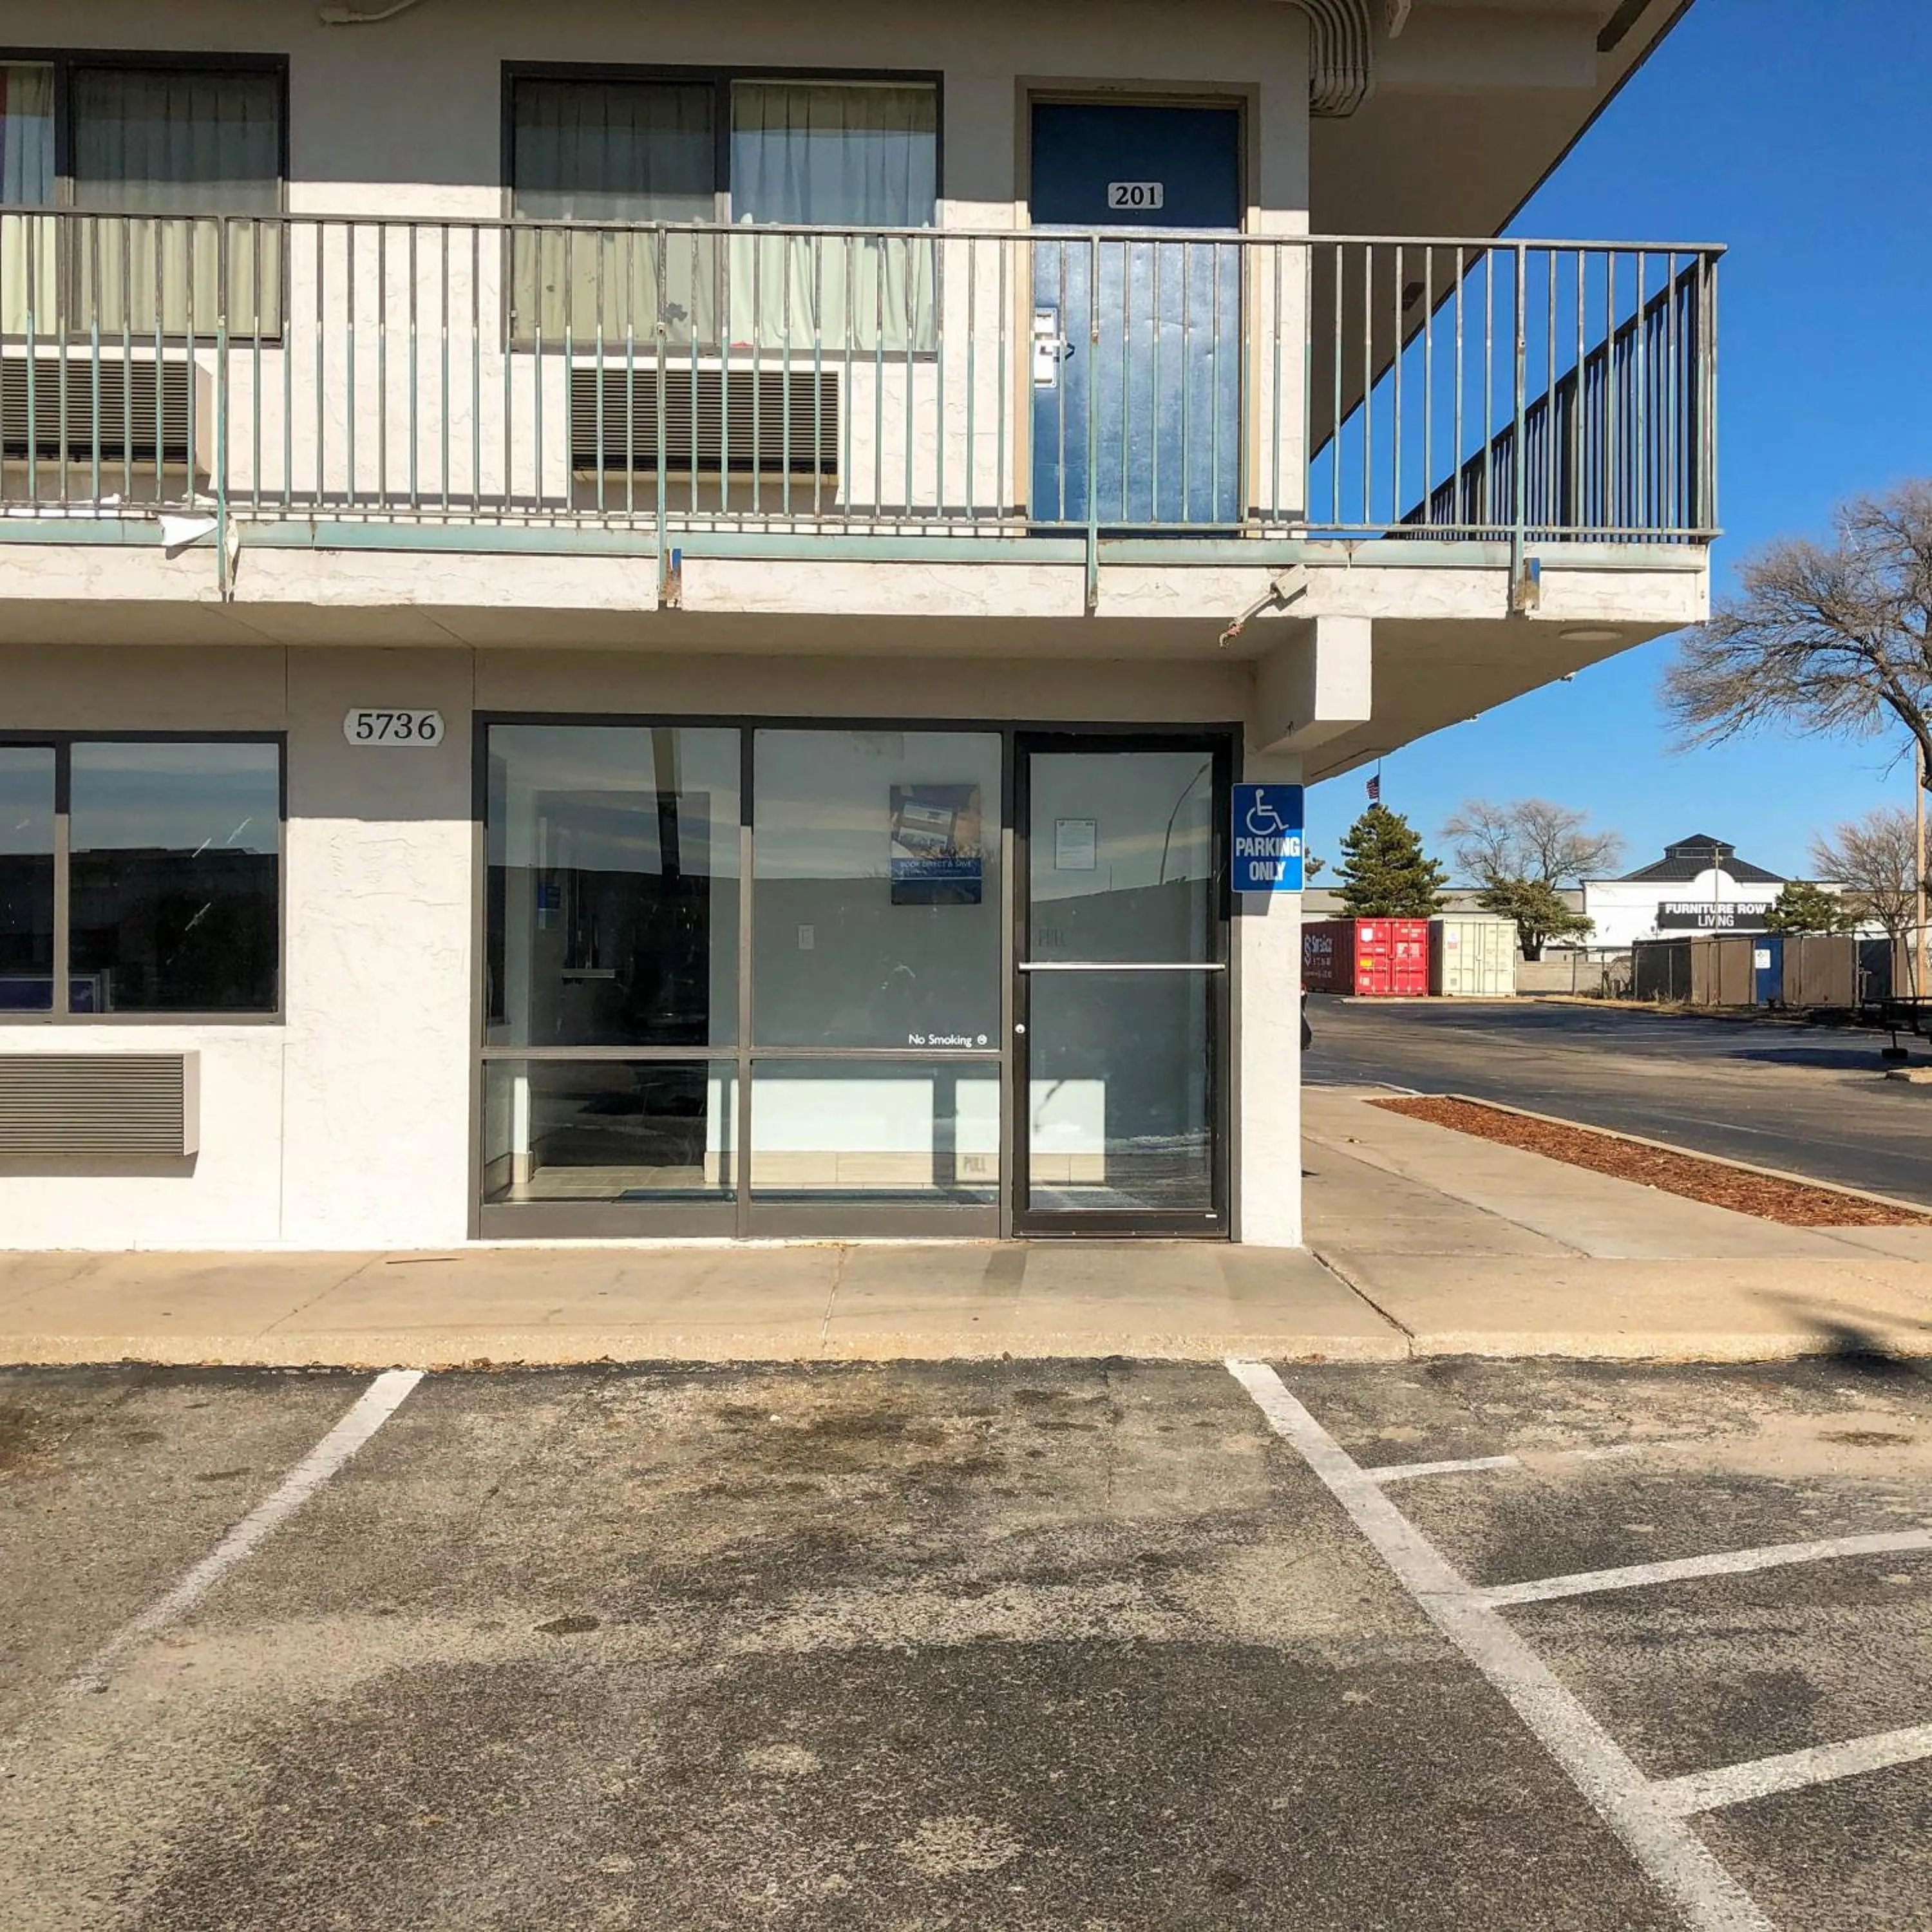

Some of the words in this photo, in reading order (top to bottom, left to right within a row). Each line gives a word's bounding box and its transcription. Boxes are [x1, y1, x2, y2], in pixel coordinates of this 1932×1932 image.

[1115, 185, 1156, 205] 201
[356, 713, 436, 739] 5736
[1236, 837, 1300, 857] PARKING
[1249, 861, 1287, 881] ONLY
[1665, 903, 1734, 914] FURNITURE
[1737, 903, 1766, 914] ROW
[1698, 915, 1734, 927] LIVNG
[909, 1034, 925, 1045] No
[928, 1034, 972, 1048] Smoking
